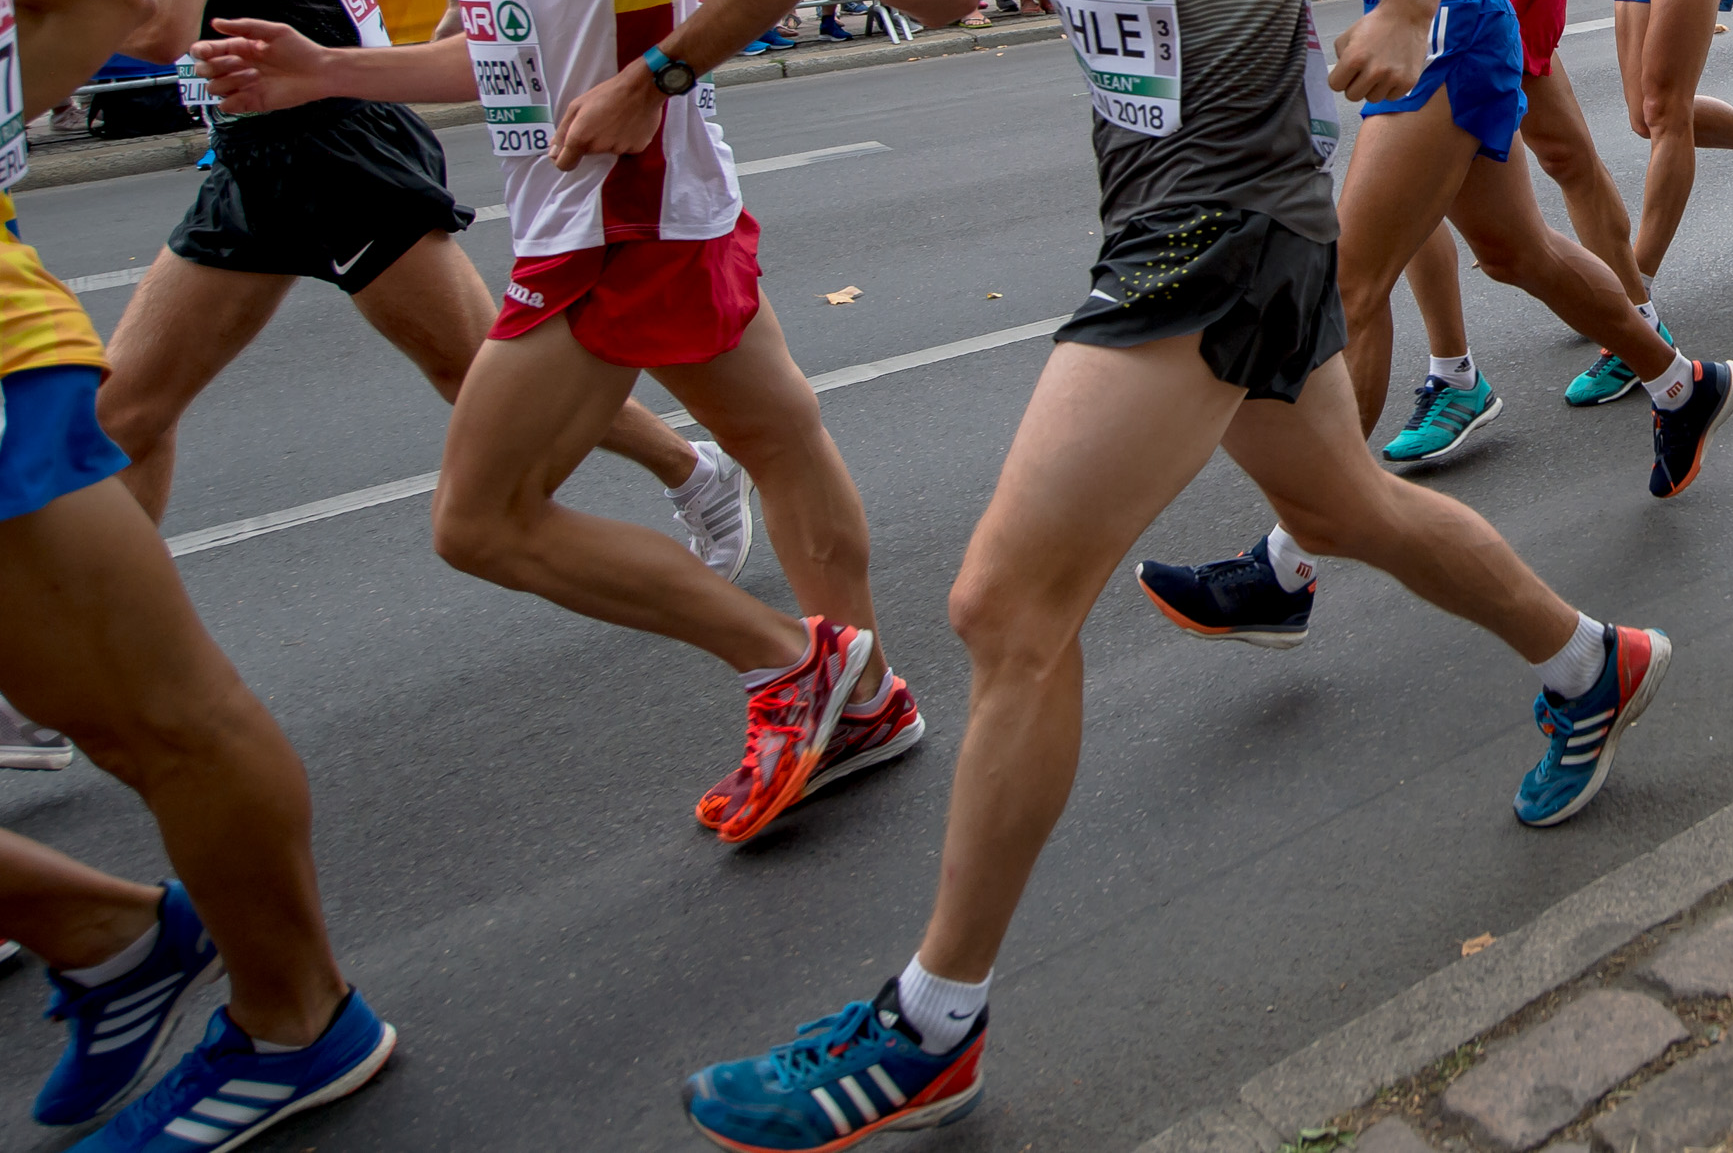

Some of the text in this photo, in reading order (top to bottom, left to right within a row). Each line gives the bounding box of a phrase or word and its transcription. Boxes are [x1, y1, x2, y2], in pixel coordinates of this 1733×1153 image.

[1064, 5, 1146, 59] HLE
[1113, 99, 1164, 130] 2018
[496, 129, 549, 151] 2018
